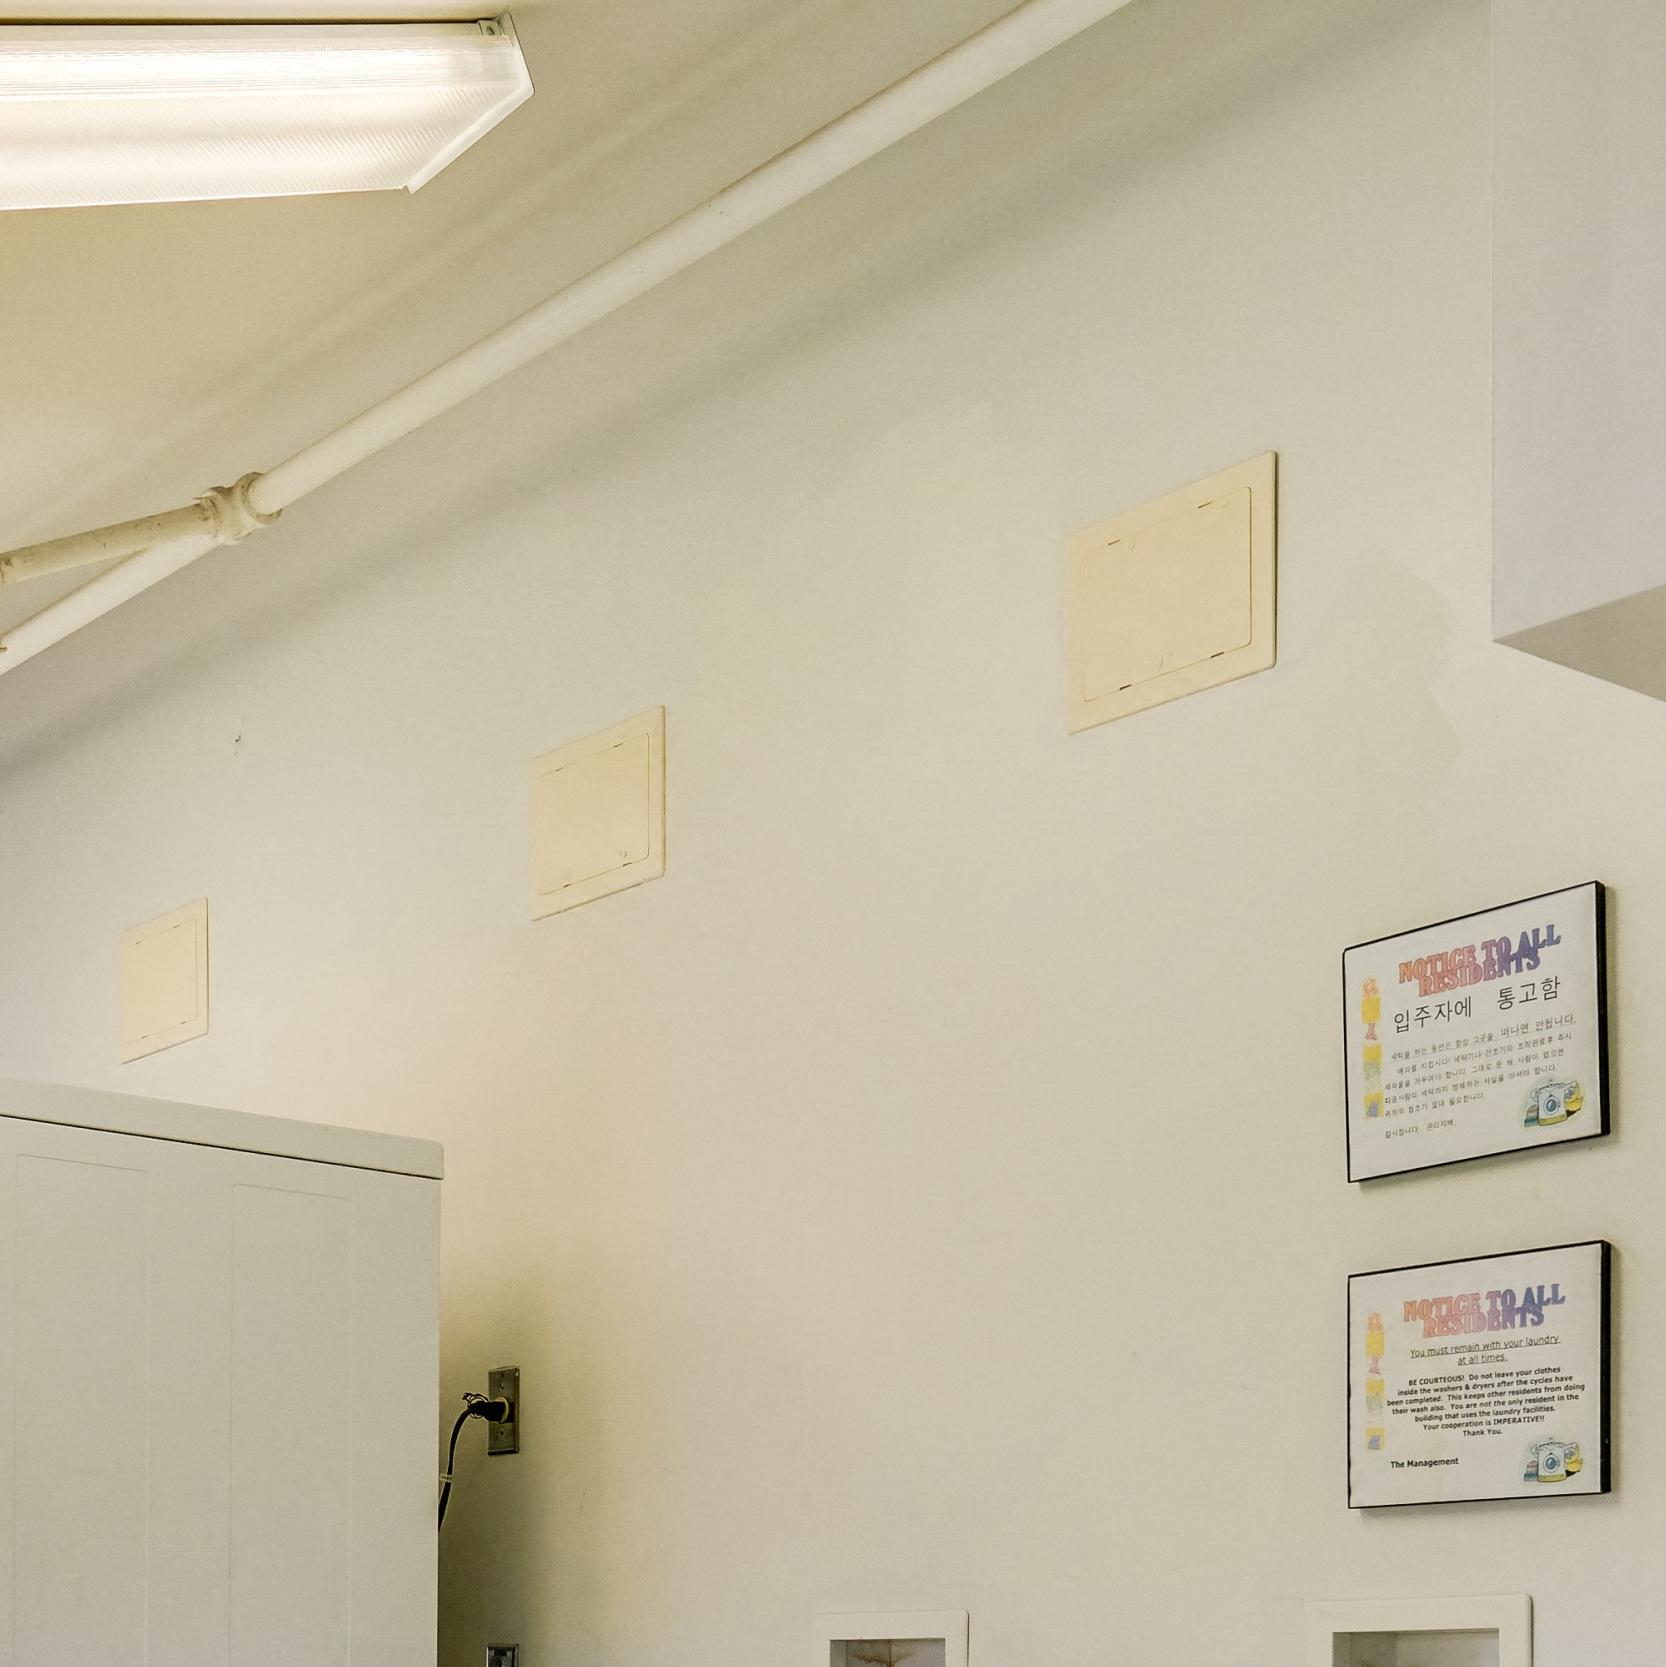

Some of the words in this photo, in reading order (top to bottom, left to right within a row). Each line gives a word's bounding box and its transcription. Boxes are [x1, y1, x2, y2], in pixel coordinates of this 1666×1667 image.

[1398, 944, 1476, 983] NOTICE
[1481, 934, 1511, 963] TO
[1516, 922, 1561, 954] ALL
[1418, 946, 1540, 997] RESIDENTS
[1394, 995, 1470, 1035] 입주자에
[1497, 974, 1560, 1011] 통고함
[1403, 1292, 1480, 1322] NOTICE
[1485, 1288, 1516, 1312] TO
[1521, 1282, 1565, 1308] ALL
[1422, 1302, 1544, 1338] RESIDENTS
[1410, 1348, 1424, 1357] You
[1427, 1345, 1448, 1355] must
[1450, 1342, 1479, 1353] remain
[1483, 1340, 1500, 1349] with
[1503, 1337, 1522, 1349] your
[1525, 1334, 1558, 1347] laundry
[1457, 1356, 1467, 1365] at
[1468, 1355, 1478, 1364] all
[1481, 1352, 1507, 1362] times.
[1533, 1365, 1561, 1374] clothes
[1440, 1420, 1483, 1430] cooperation
[1406, 1457, 1459, 1469] Management
